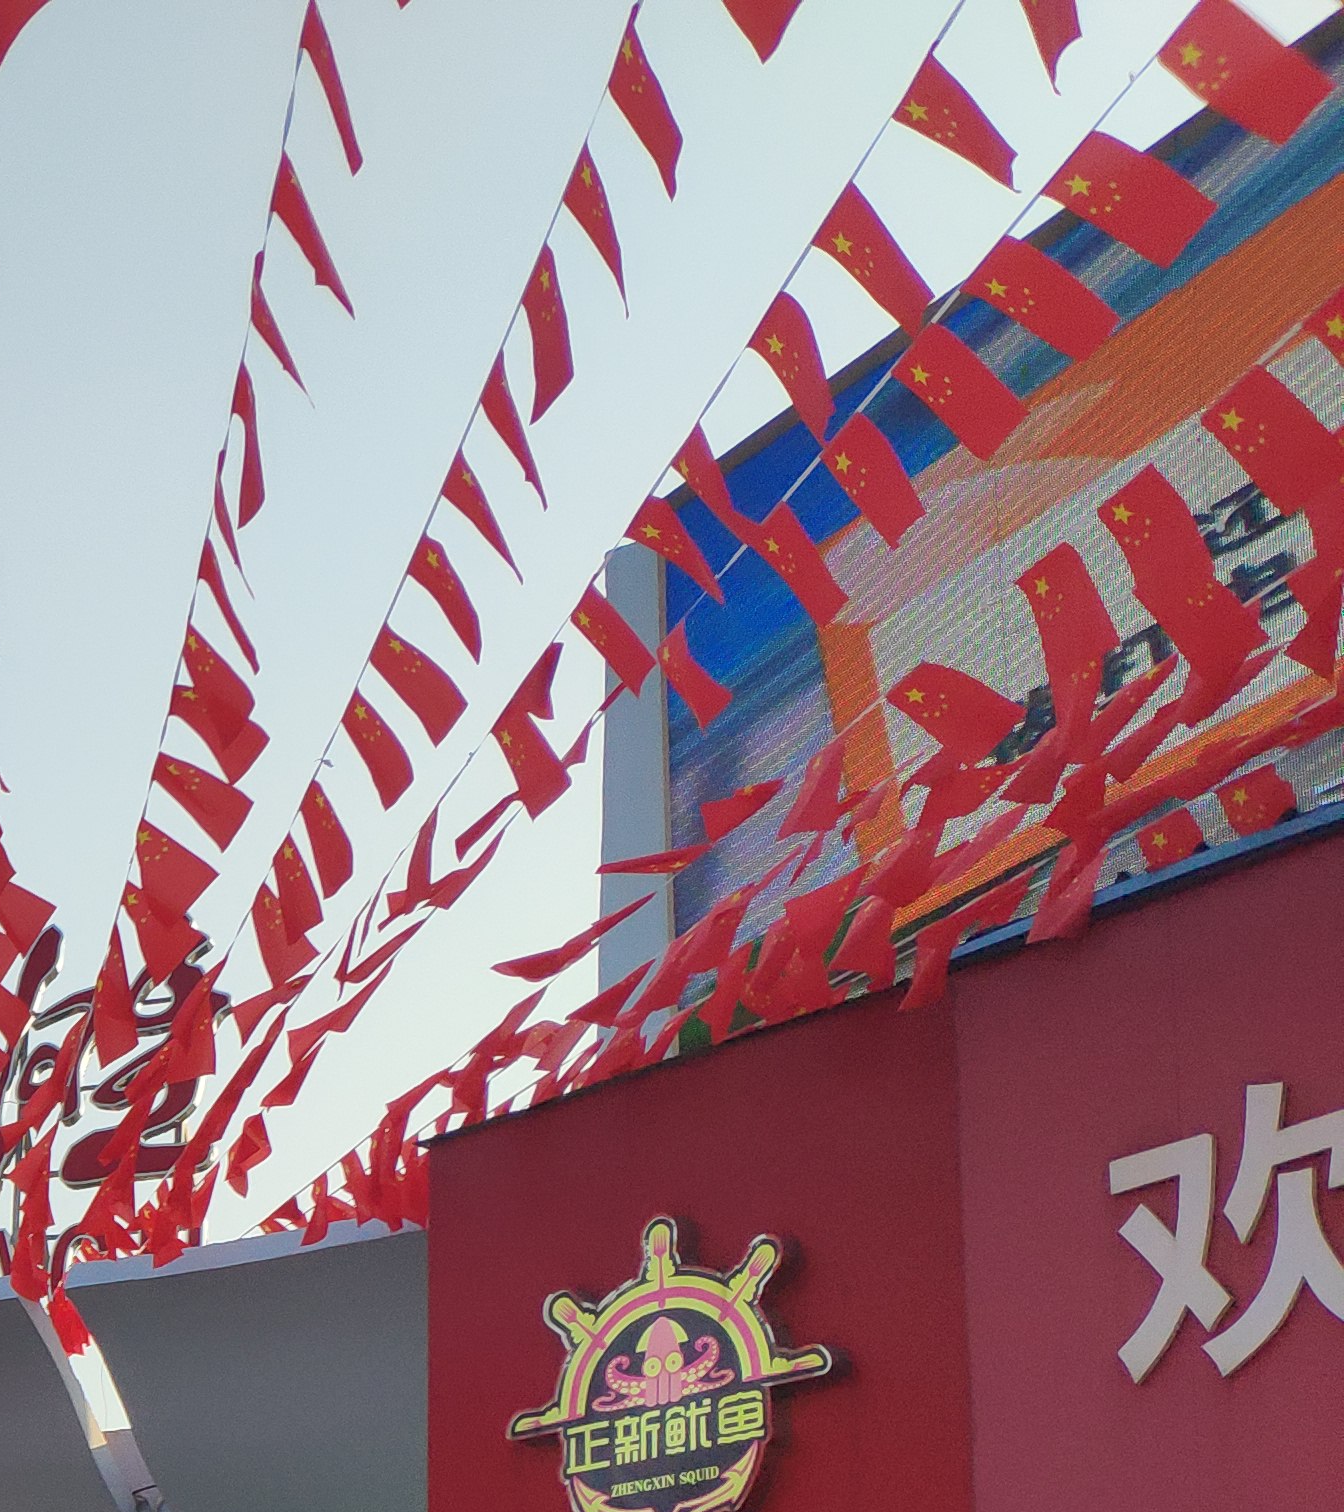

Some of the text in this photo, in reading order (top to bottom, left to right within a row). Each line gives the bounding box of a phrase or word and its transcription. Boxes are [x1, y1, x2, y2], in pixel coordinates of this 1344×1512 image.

[566, 1390, 765, 1474] 正新鱿鱼
[611, 1465, 720, 1498] ZHENGXIN SQUID
